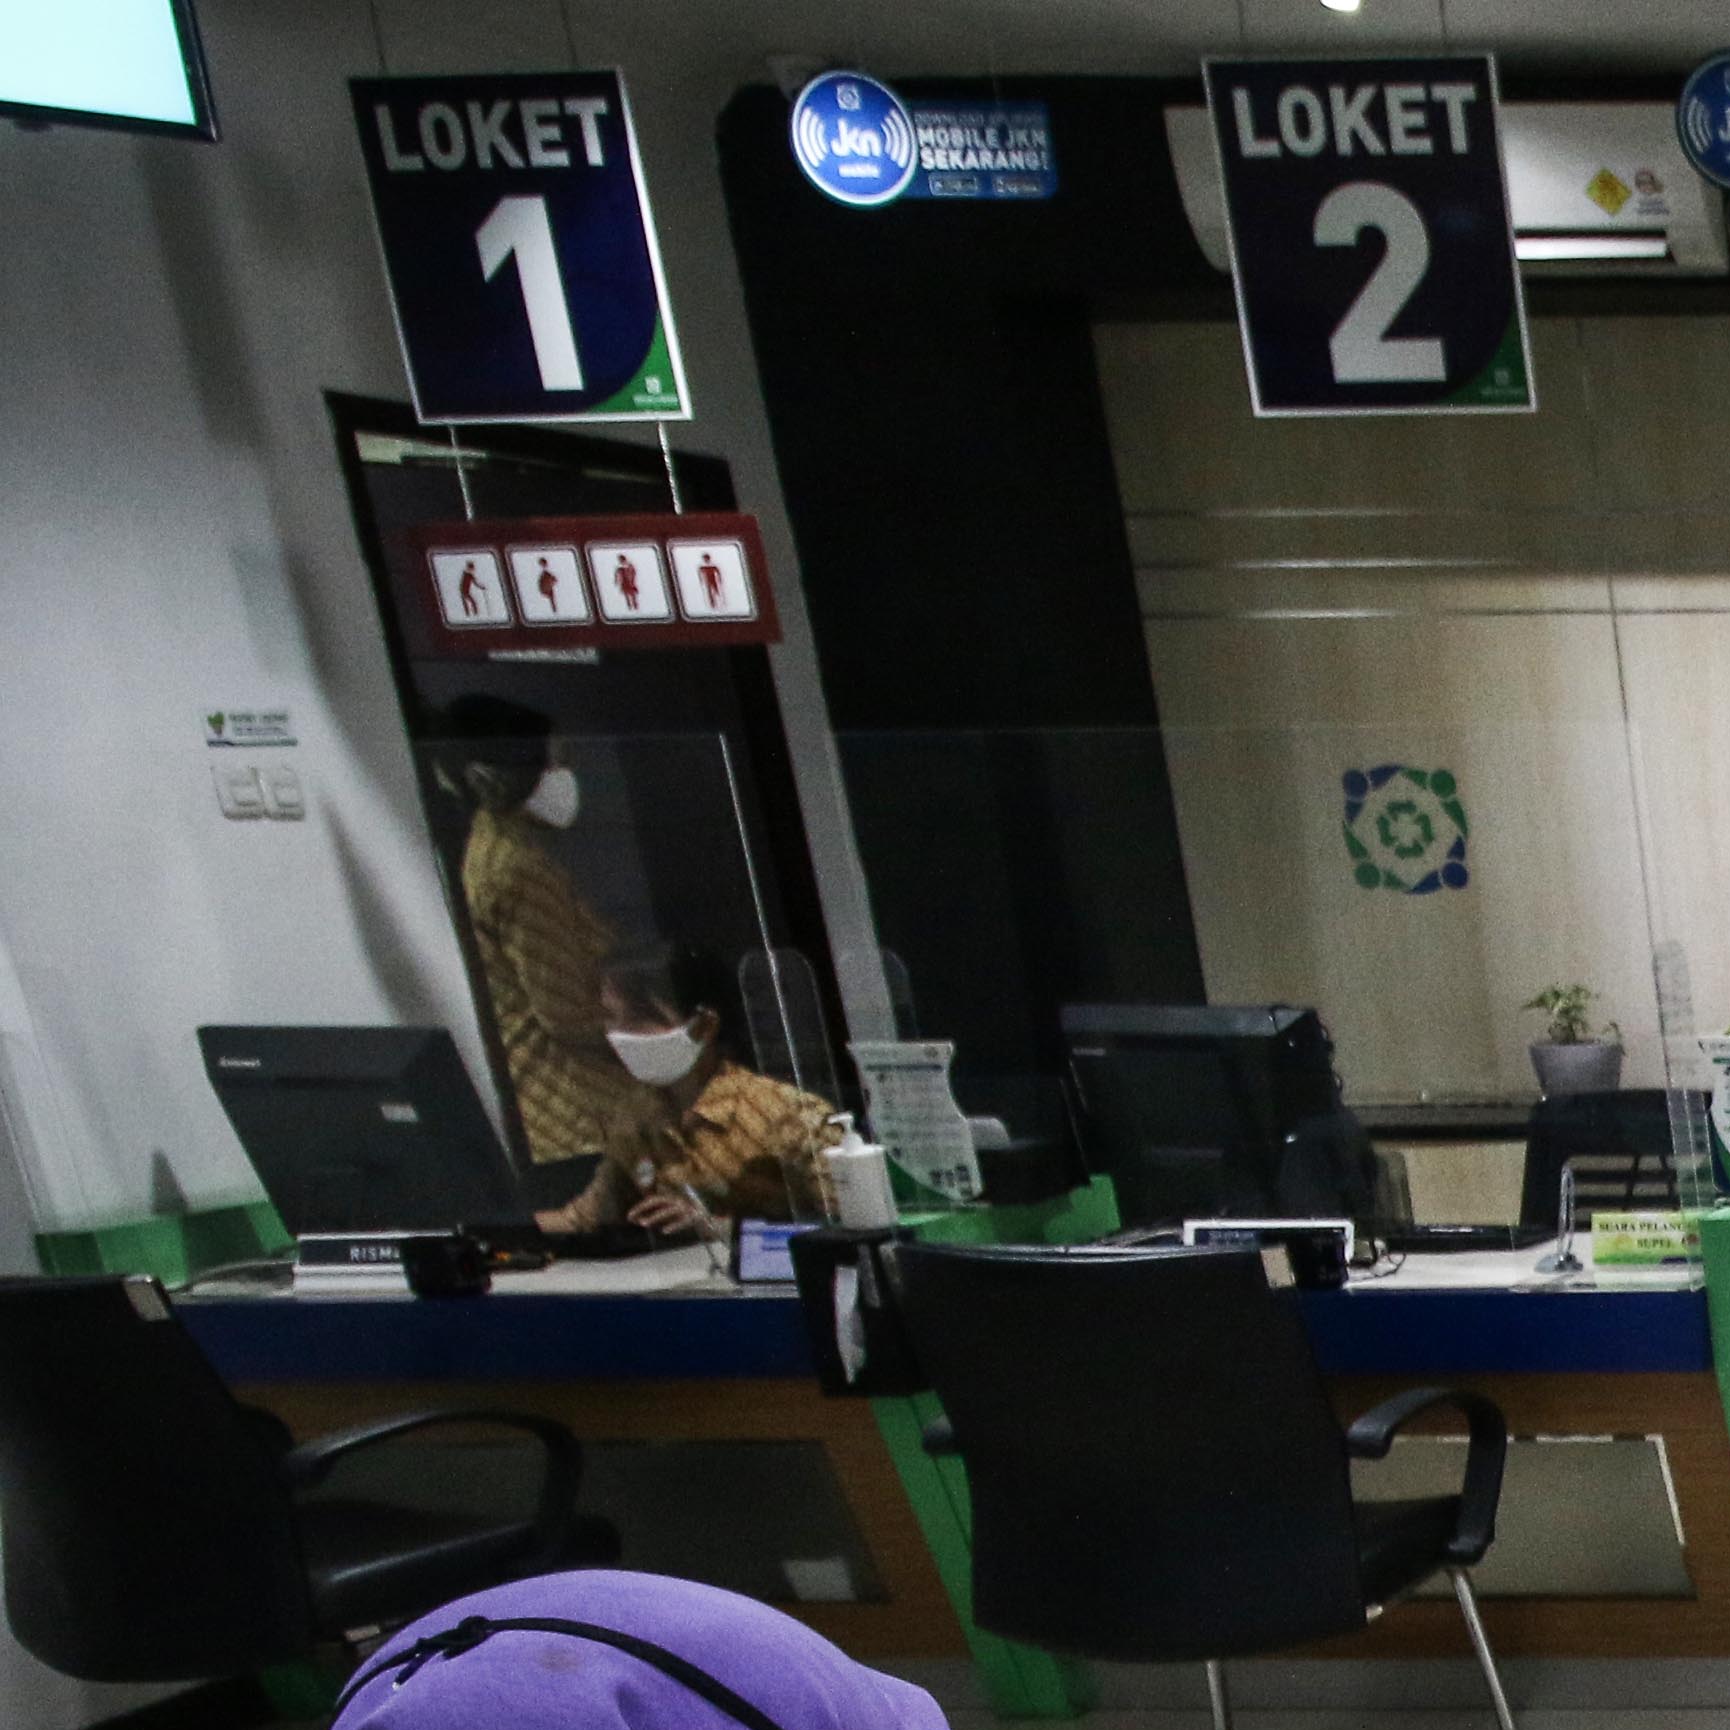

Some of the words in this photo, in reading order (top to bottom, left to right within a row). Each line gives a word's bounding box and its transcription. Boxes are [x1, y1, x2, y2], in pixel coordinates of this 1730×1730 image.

[374, 98, 608, 173] LOKET
[917, 127, 999, 149] MOBILE
[1006, 127, 1046, 148] JKN
[1232, 84, 1477, 158] LOKET
[920, 149, 1049, 171] SEKARANG!
[477, 196, 584, 392] 1
[1313, 183, 1446, 383] 2
